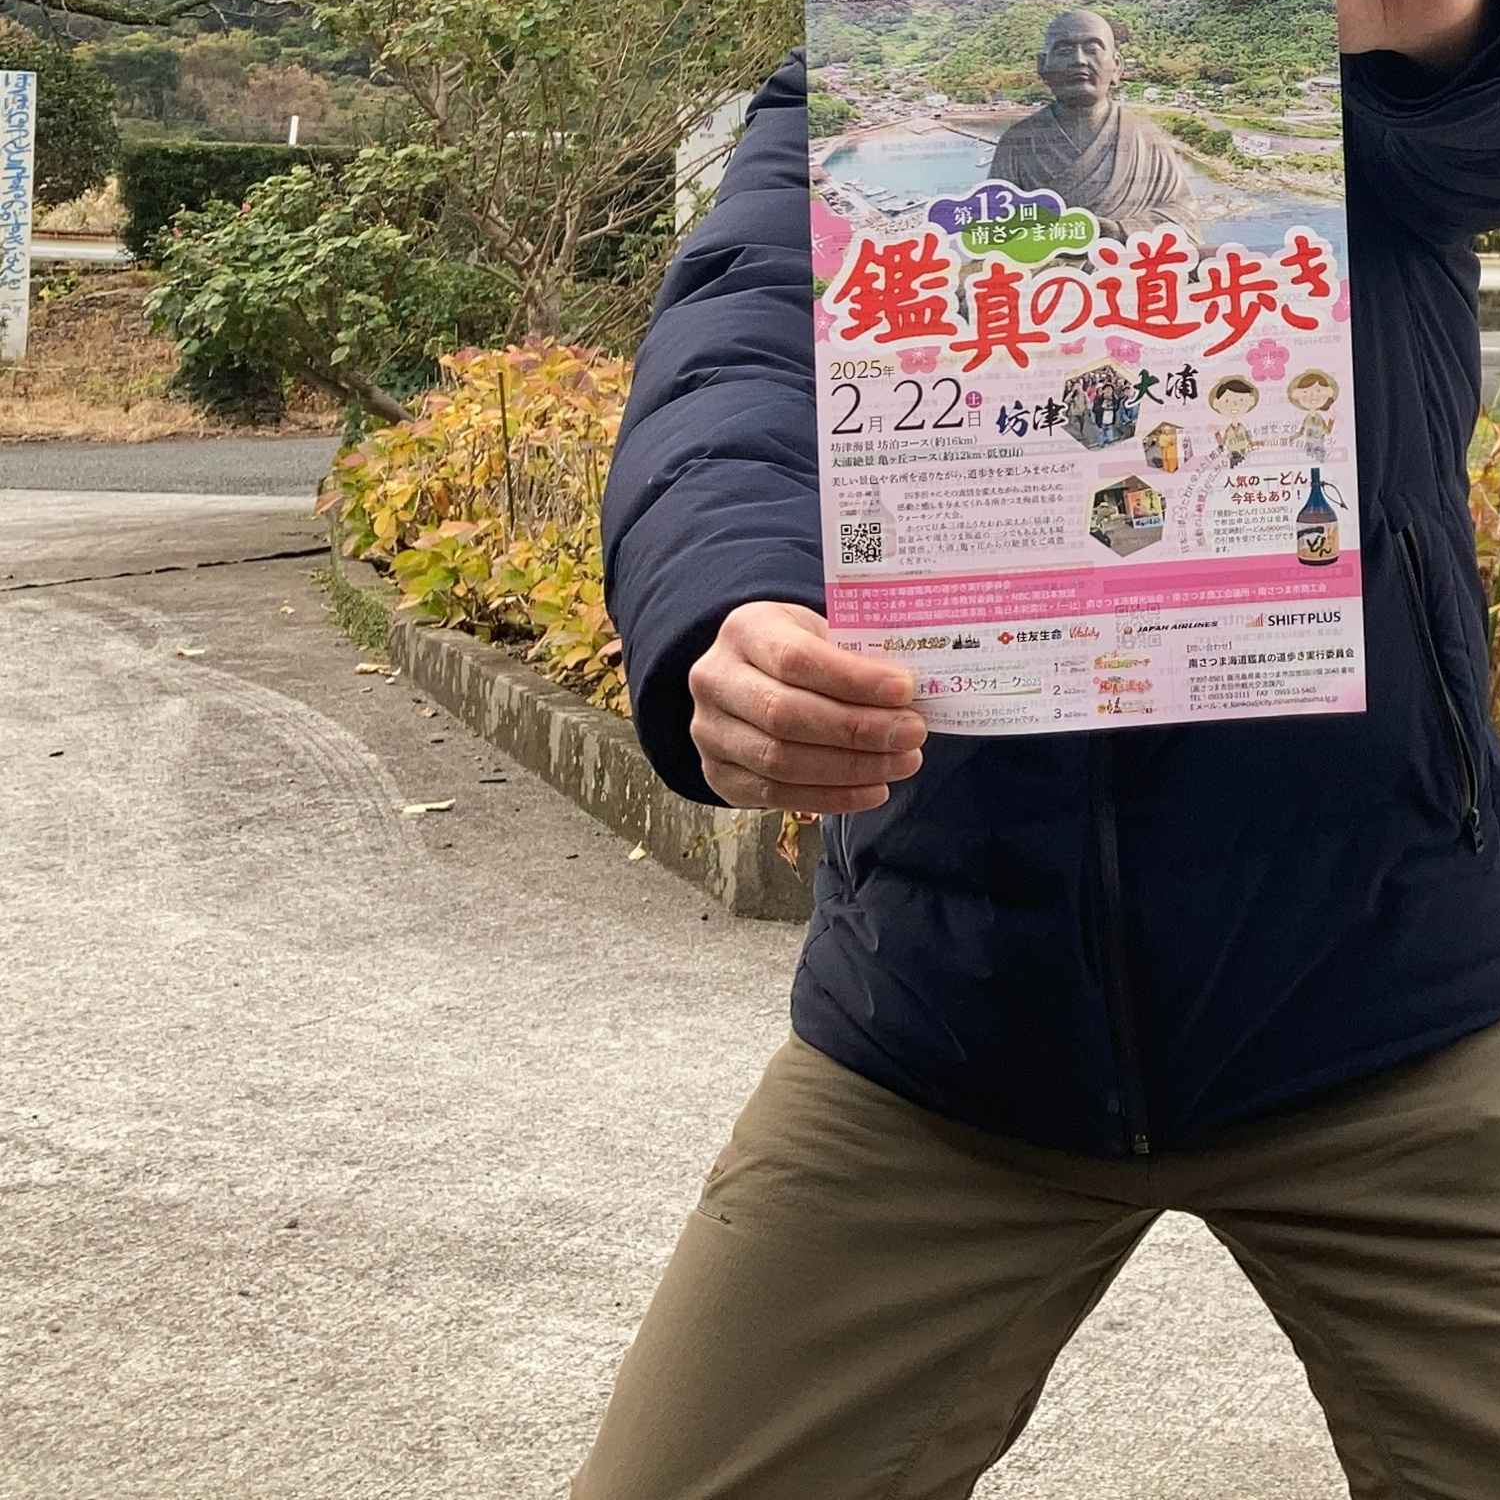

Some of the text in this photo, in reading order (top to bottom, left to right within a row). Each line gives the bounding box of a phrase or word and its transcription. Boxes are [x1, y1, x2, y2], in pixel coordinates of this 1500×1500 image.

[953, 192, 1039, 227] 第13回
[970, 219, 1088, 246] 南さつま海道
[833, 232, 1332, 373] 鑑真の道歩き
[829, 359, 896, 381] 2025年
[1132, 363, 1199, 407] 大浦
[995, 396, 1069, 438] 坊津
[830, 439, 875, 454] 坊津海景
[831, 454, 875, 469] 大浦絶景
[1230, 489, 1302, 506] 今年もあり!
[1016, 628, 1063, 643] 住友生命
[1136, 620, 1218, 633] JAPAN AIRLINES
[1188, 647, 1355, 669] 南さつま海道鑑真の道歩き実行委員会
